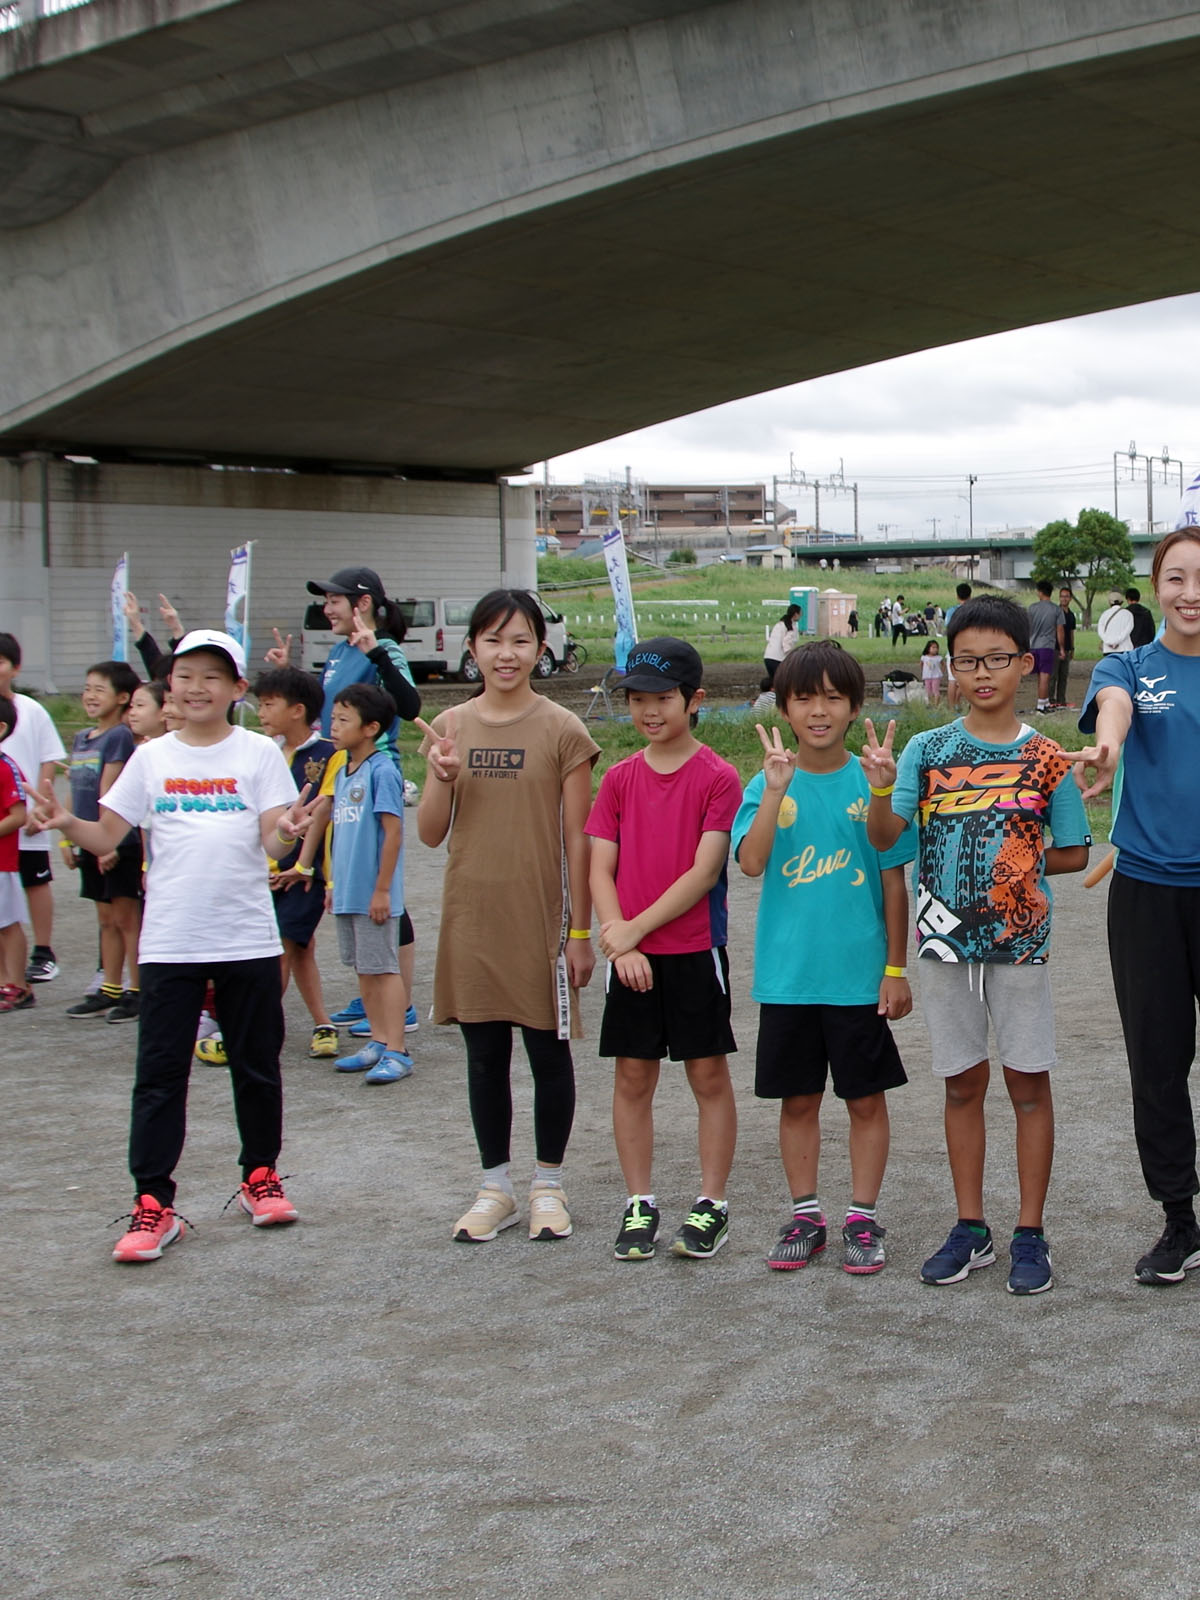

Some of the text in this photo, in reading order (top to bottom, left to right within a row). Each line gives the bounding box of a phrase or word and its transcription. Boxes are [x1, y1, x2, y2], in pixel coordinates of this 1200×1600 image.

[627, 652, 671, 672] FLEXIBLE
[472, 750, 509, 767] CUTE
[472, 770, 517, 779] MY FAVORITE
[926, 763, 1029, 798] NO
[782, 845, 851, 888] Luz
